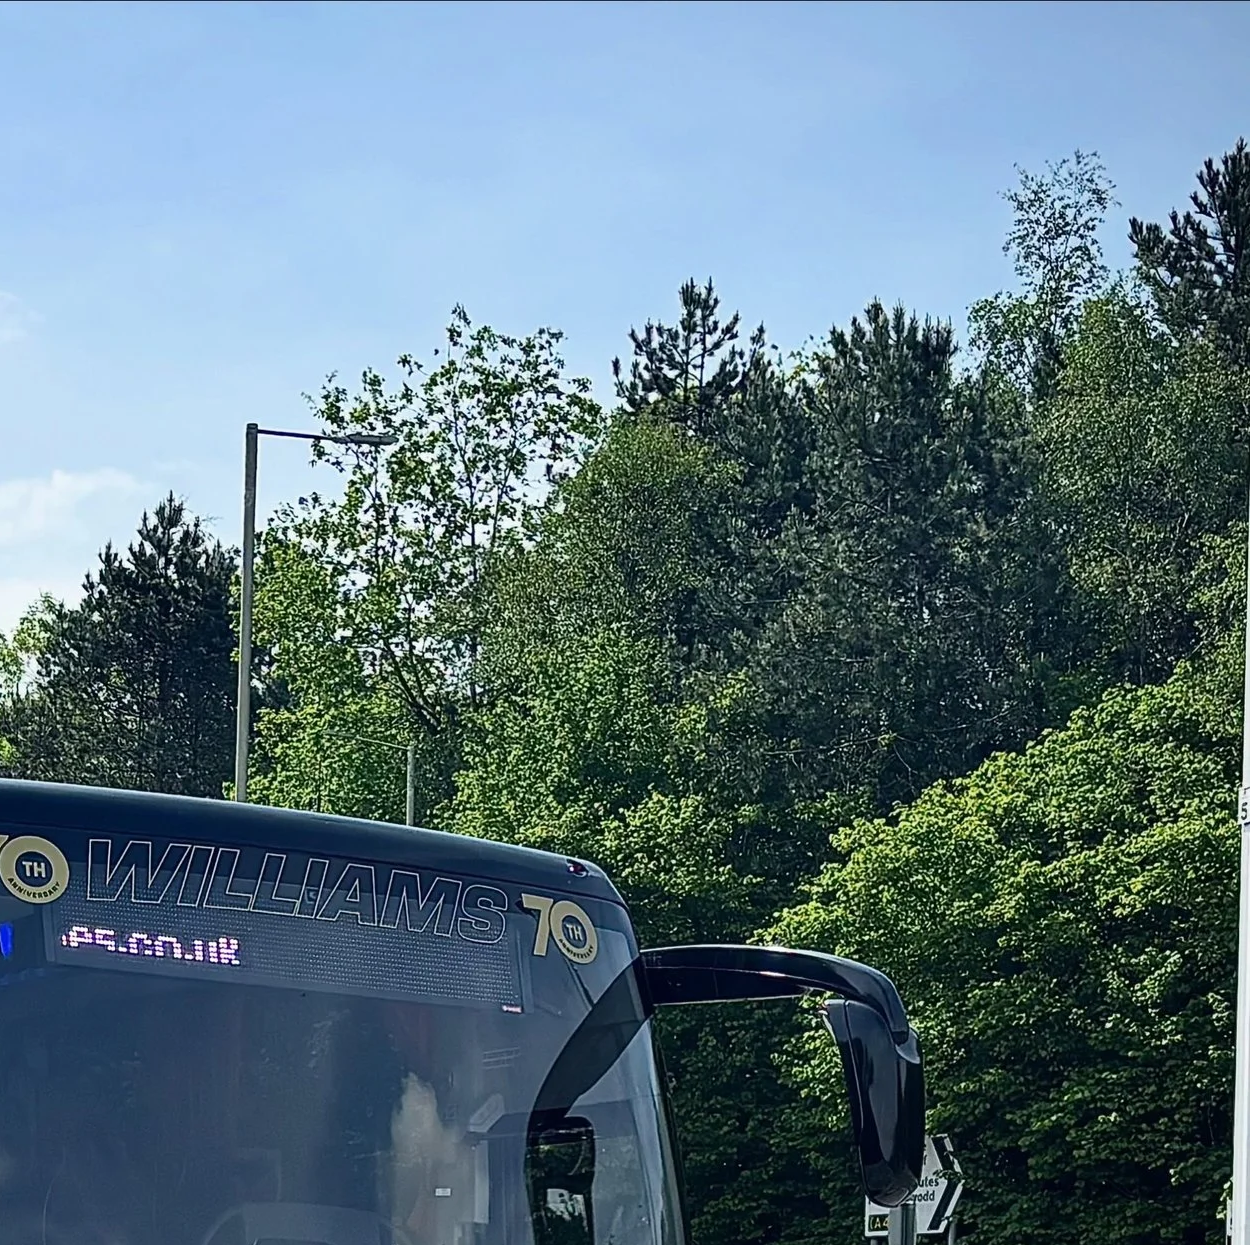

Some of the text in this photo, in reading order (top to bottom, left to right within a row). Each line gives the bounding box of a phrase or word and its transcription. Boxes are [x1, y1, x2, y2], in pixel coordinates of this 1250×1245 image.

[22, 861, 46, 878] TH
[7, 877, 61, 900] ANNIVERSARY
[86, 838, 508, 944] WILLIAMS
[521, 893, 598, 964] 70
[565, 923, 584, 941] TH
[917, 1176, 940, 1188] utes
